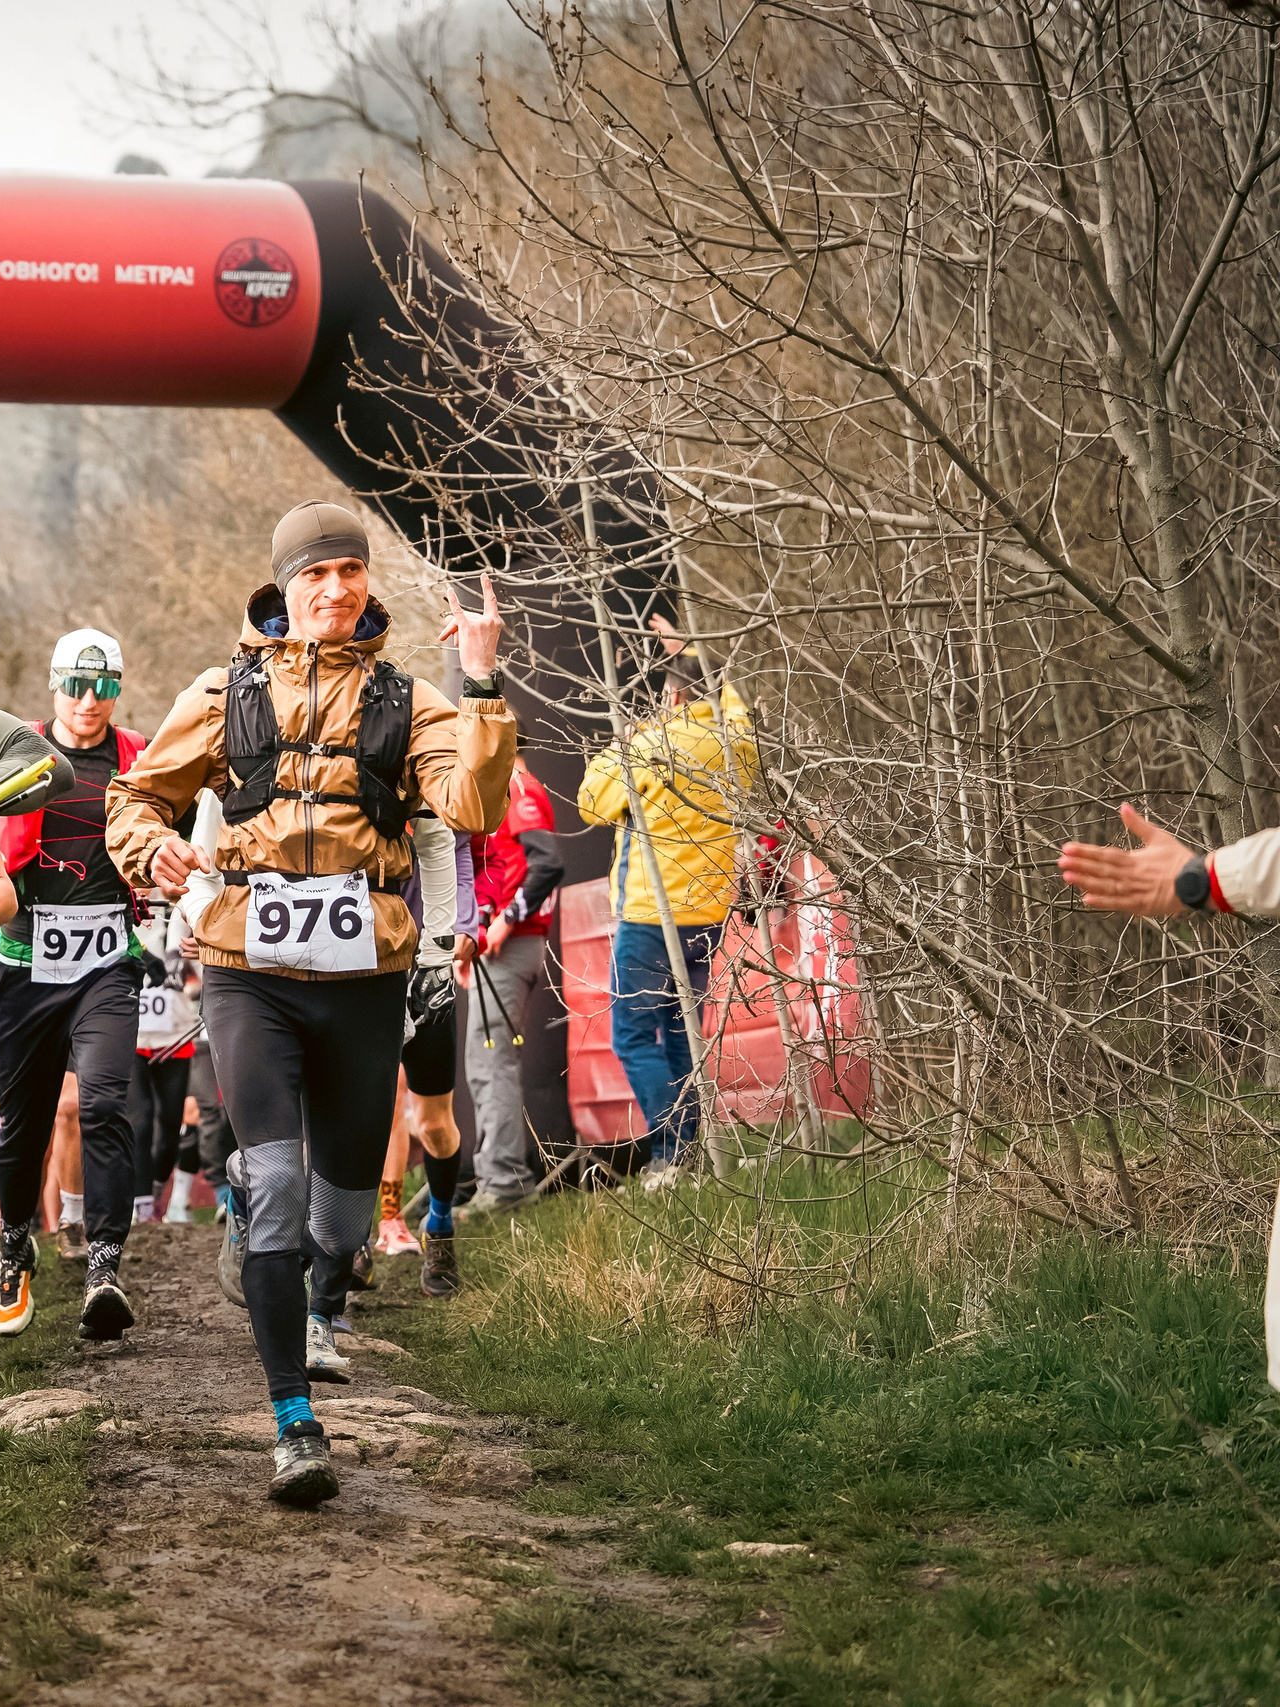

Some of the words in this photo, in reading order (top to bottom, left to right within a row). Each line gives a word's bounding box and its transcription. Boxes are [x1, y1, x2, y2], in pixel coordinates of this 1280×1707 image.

[115, 264, 194, 286] МЕТРА!
[258, 896, 363, 944] 976
[43, 926, 118, 962] 970
